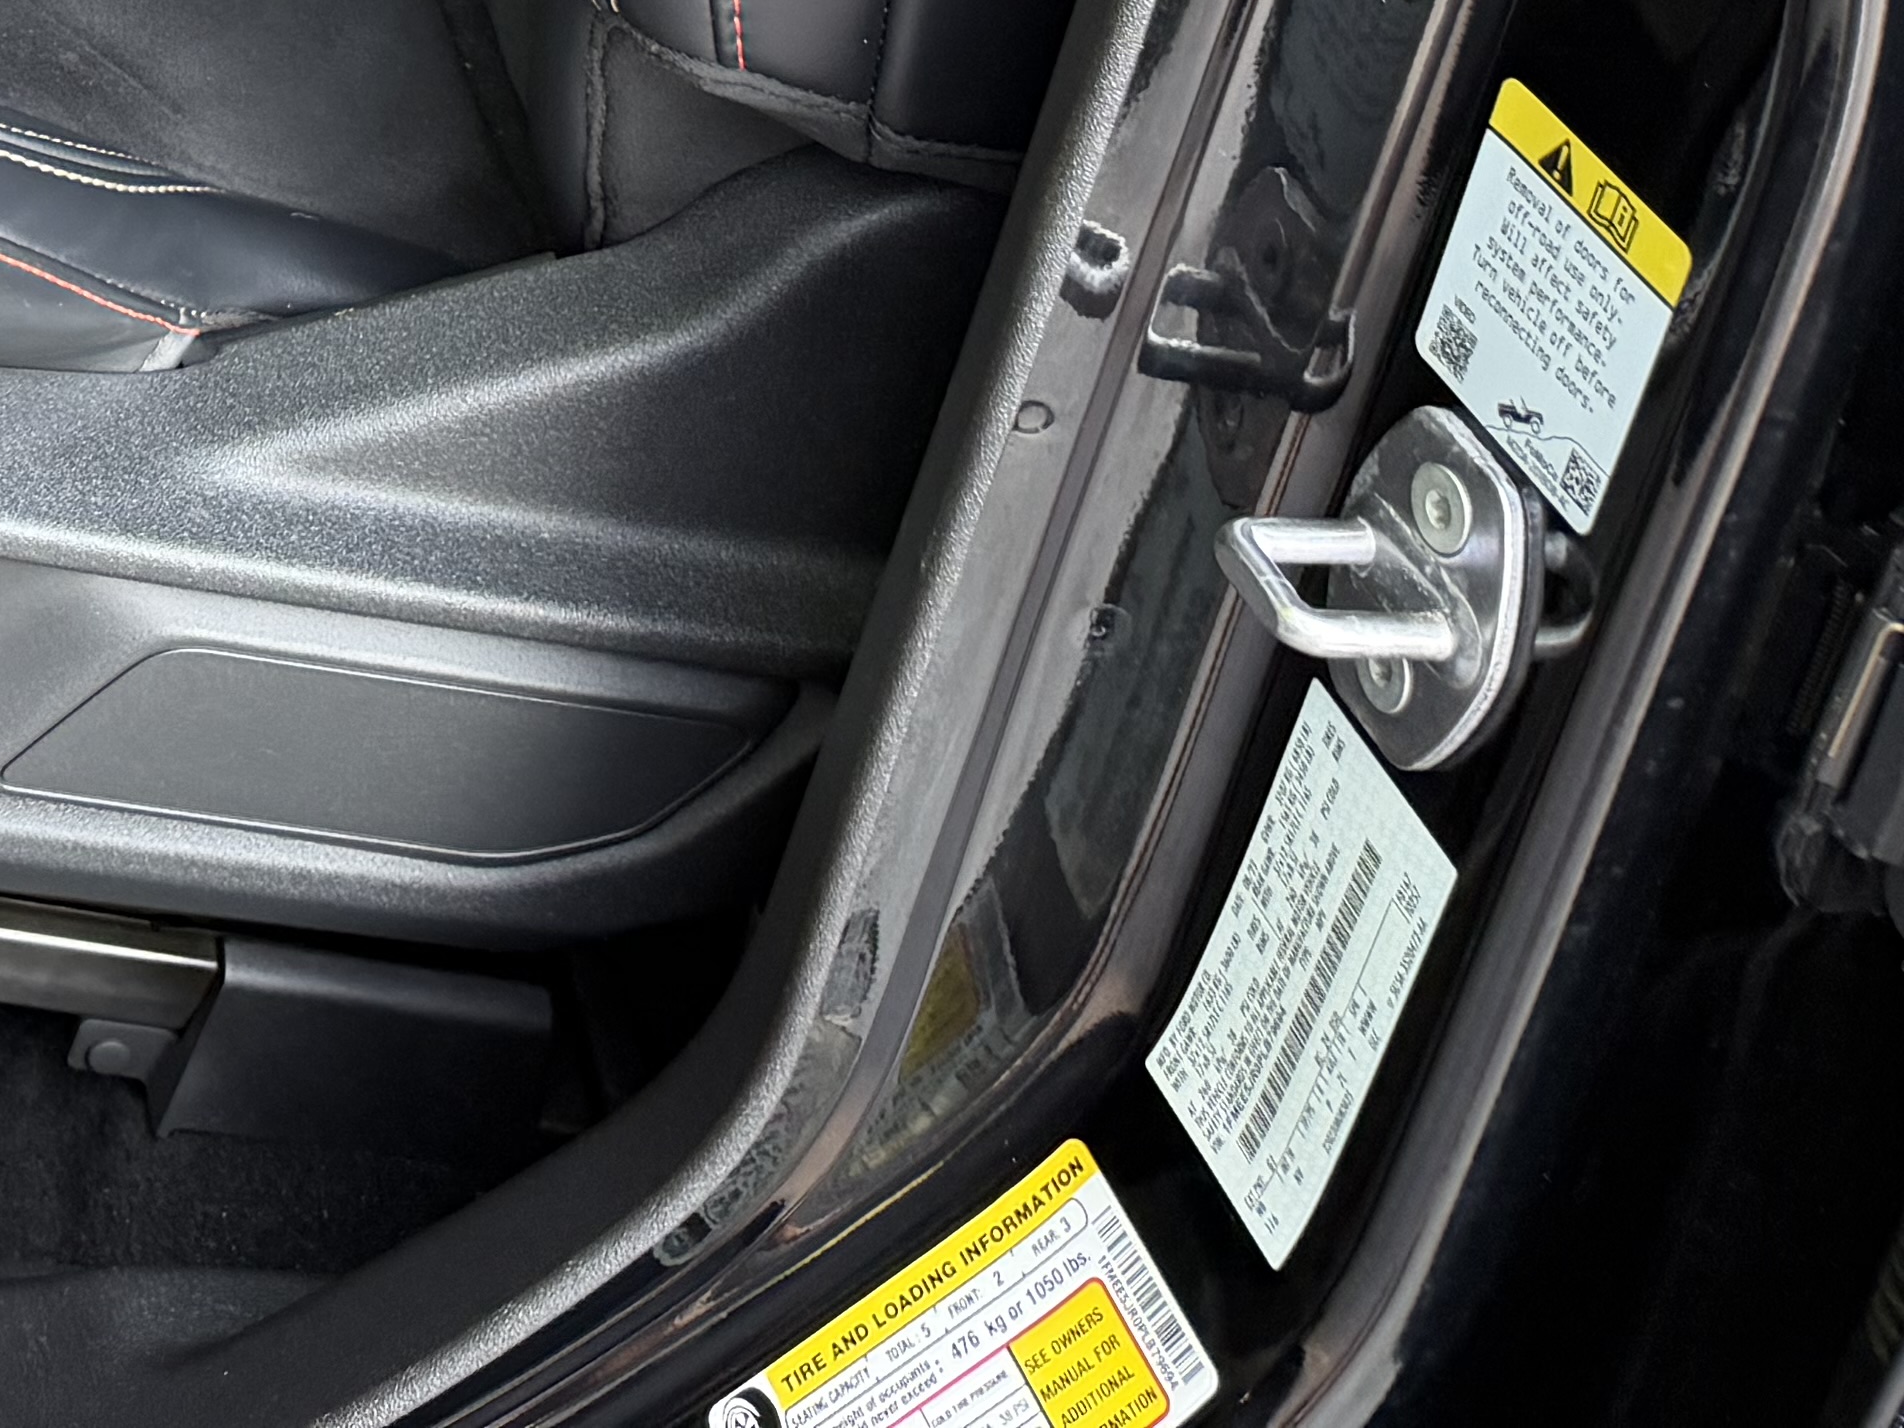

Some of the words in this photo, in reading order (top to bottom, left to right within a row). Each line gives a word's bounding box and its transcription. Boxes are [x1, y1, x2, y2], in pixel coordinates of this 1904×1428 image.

[1498, 215, 1528, 256] Will
[1529, 249, 1573, 303] affect
[1572, 296, 1618, 354] safety
[1505, 165, 1554, 223] Removal
[1553, 215, 1570, 241] of
[1572, 235, 1610, 282] doors
[1612, 275, 1637, 309] for
[1506, 196, 1562, 262] off-road
[1562, 256, 1586, 287] use
[1586, 280, 1626, 331] only.
[1452, 293, 1477, 326] VIDEO
[1470, 243, 1499, 283] Turn
[1499, 276, 1549, 337] vehicle
[1548, 326, 1573, 362] off
[1573, 353, 1619, 411] before
[1472, 277, 1553, 374] reconnecting
[1553, 361, 1597, 417] doors.
[1484, 233, 1527, 287] system
[1526, 277, 1611, 376] performance.
[1168, 1029, 1179, 1049] BY
[1175, 1007, 1191, 1039] FORD
[1187, 979, 1205, 1017] MOTOR
[1218, 1059, 1247, 1118] STANDARDS
[1272, 974, 1287, 1002] DATE
[1285, 902, 1317, 968] MANUFACTURE
[1322, 840, 1341, 876] ABOVE
[1162, 1044, 1183, 1085] FRONT
[1223, 1030, 1249, 1082] CONFORMS
[1243, 1018, 1254, 1038] TO
[780, 1350, 828, 1395] TIRE
[826, 1319, 871, 1362] AND
[870, 1256, 958, 1331] LOADING
[954, 1154, 1089, 1267] INFORMATION
[789, 1394, 829, 1428] SEATING
[825, 1363, 873, 1406] CAPACITY
[918, 1321, 933, 1339] 5
[990, 1268, 1006, 1287] 2
[1057, 1214, 1073, 1234] 3
[947, 1327, 982, 1362] 476
[981, 1309, 1010, 1341] kg
[1005, 1299, 1026, 1321] or
[1023, 1265, 1067, 1307] 1050
[1060, 1244, 1093, 1277] lbs.
[863, 1395, 878, 1413] of
[875, 1356, 932, 1405] occupants
[1022, 1346, 1052, 1376] SEE
[1047, 1304, 1106, 1356] OWNERS
[1037, 1353, 1096, 1404] MANUAL
[1091, 1332, 1122, 1363] FOR
[868, 1398, 899, 1428] never
[898, 1370, 939, 1407] exceed
[1010, 1396, 1031, 1418] PSI
[1056, 1361, 1137, 1428] ADDITIONAL
